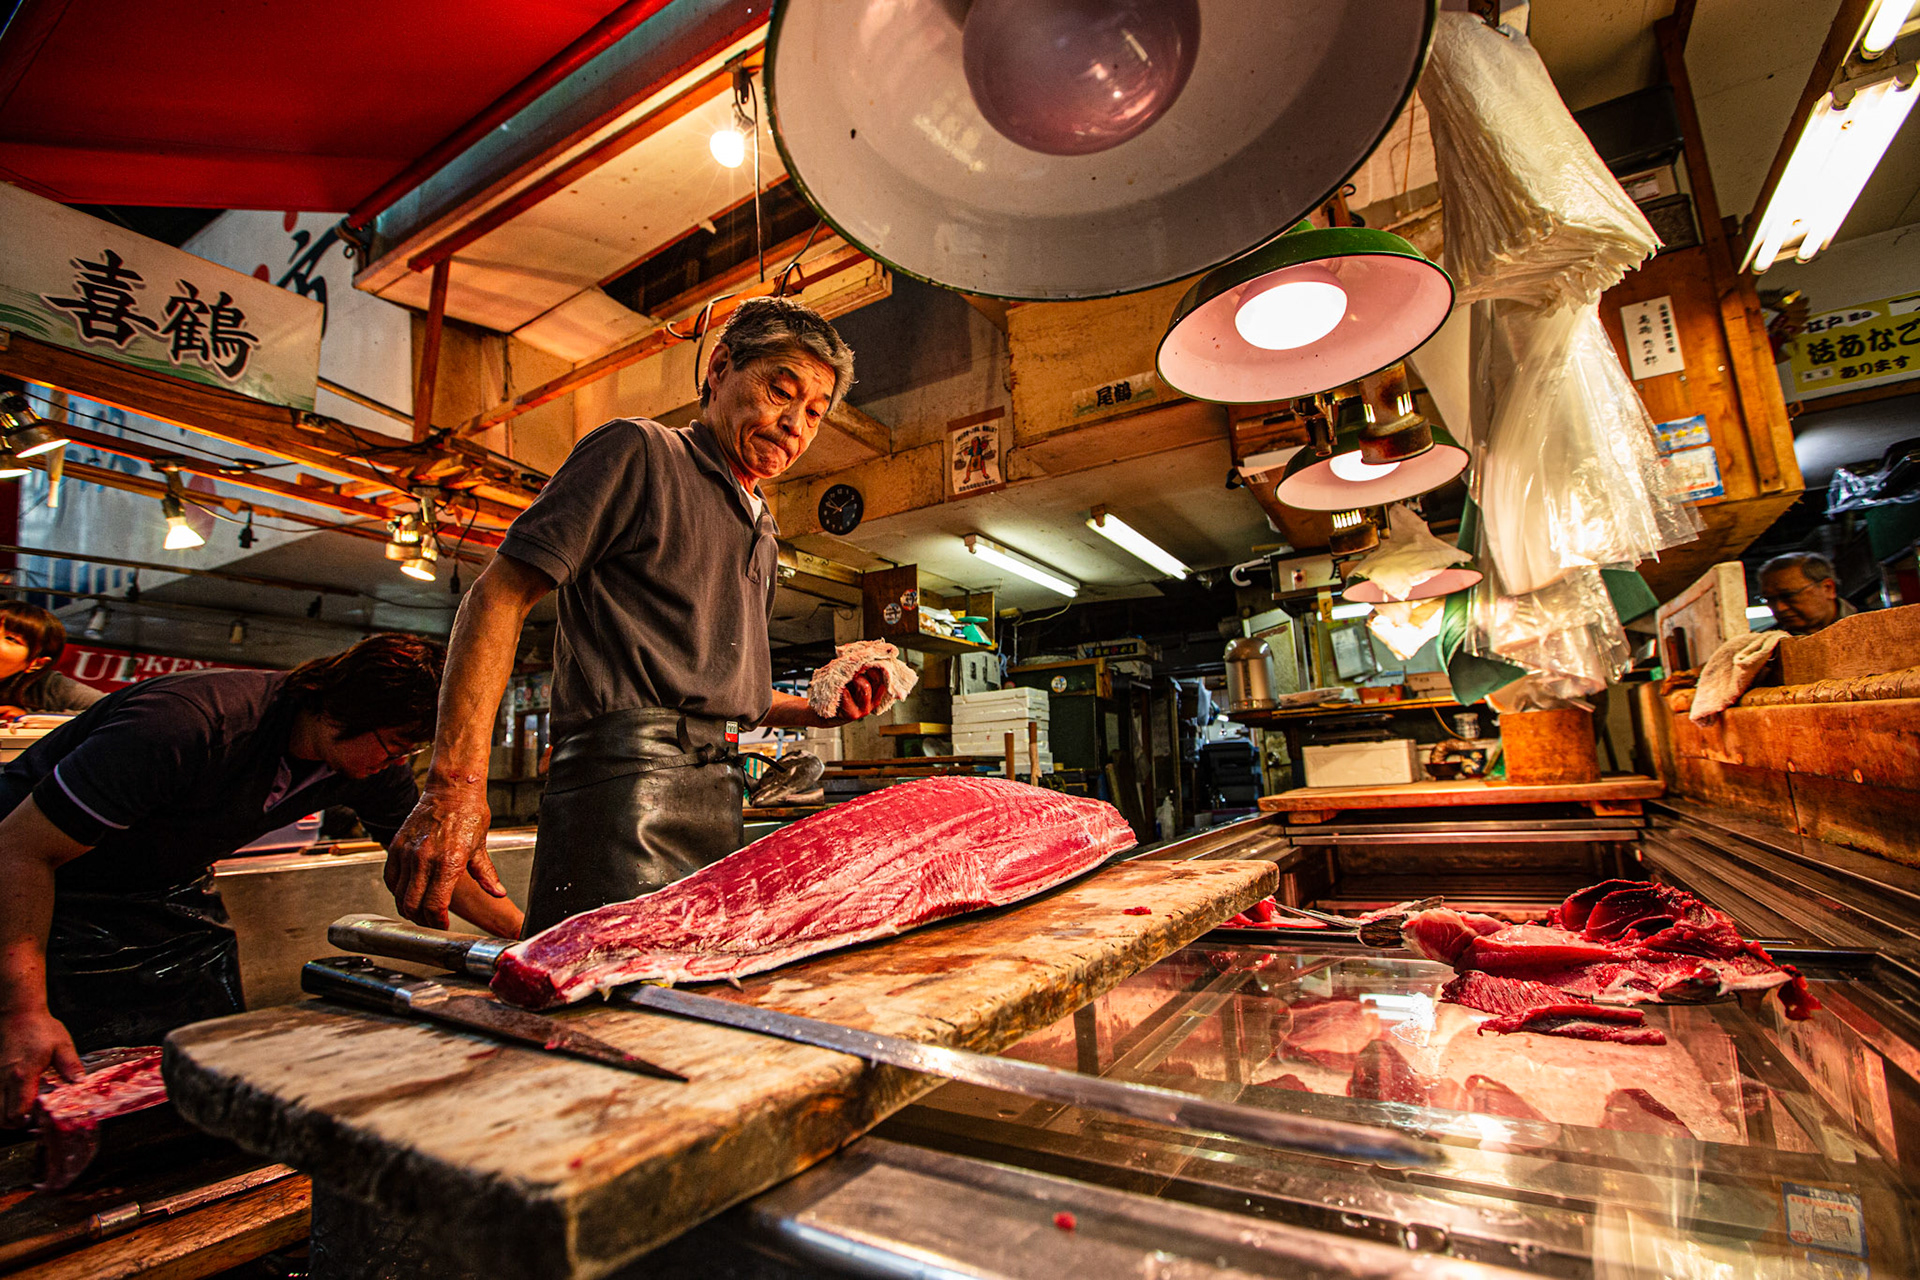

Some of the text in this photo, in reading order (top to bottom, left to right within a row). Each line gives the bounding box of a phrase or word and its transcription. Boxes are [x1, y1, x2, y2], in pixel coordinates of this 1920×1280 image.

[42, 248, 260, 380] 喜鶴
[1840, 355, 1911, 379] あります
